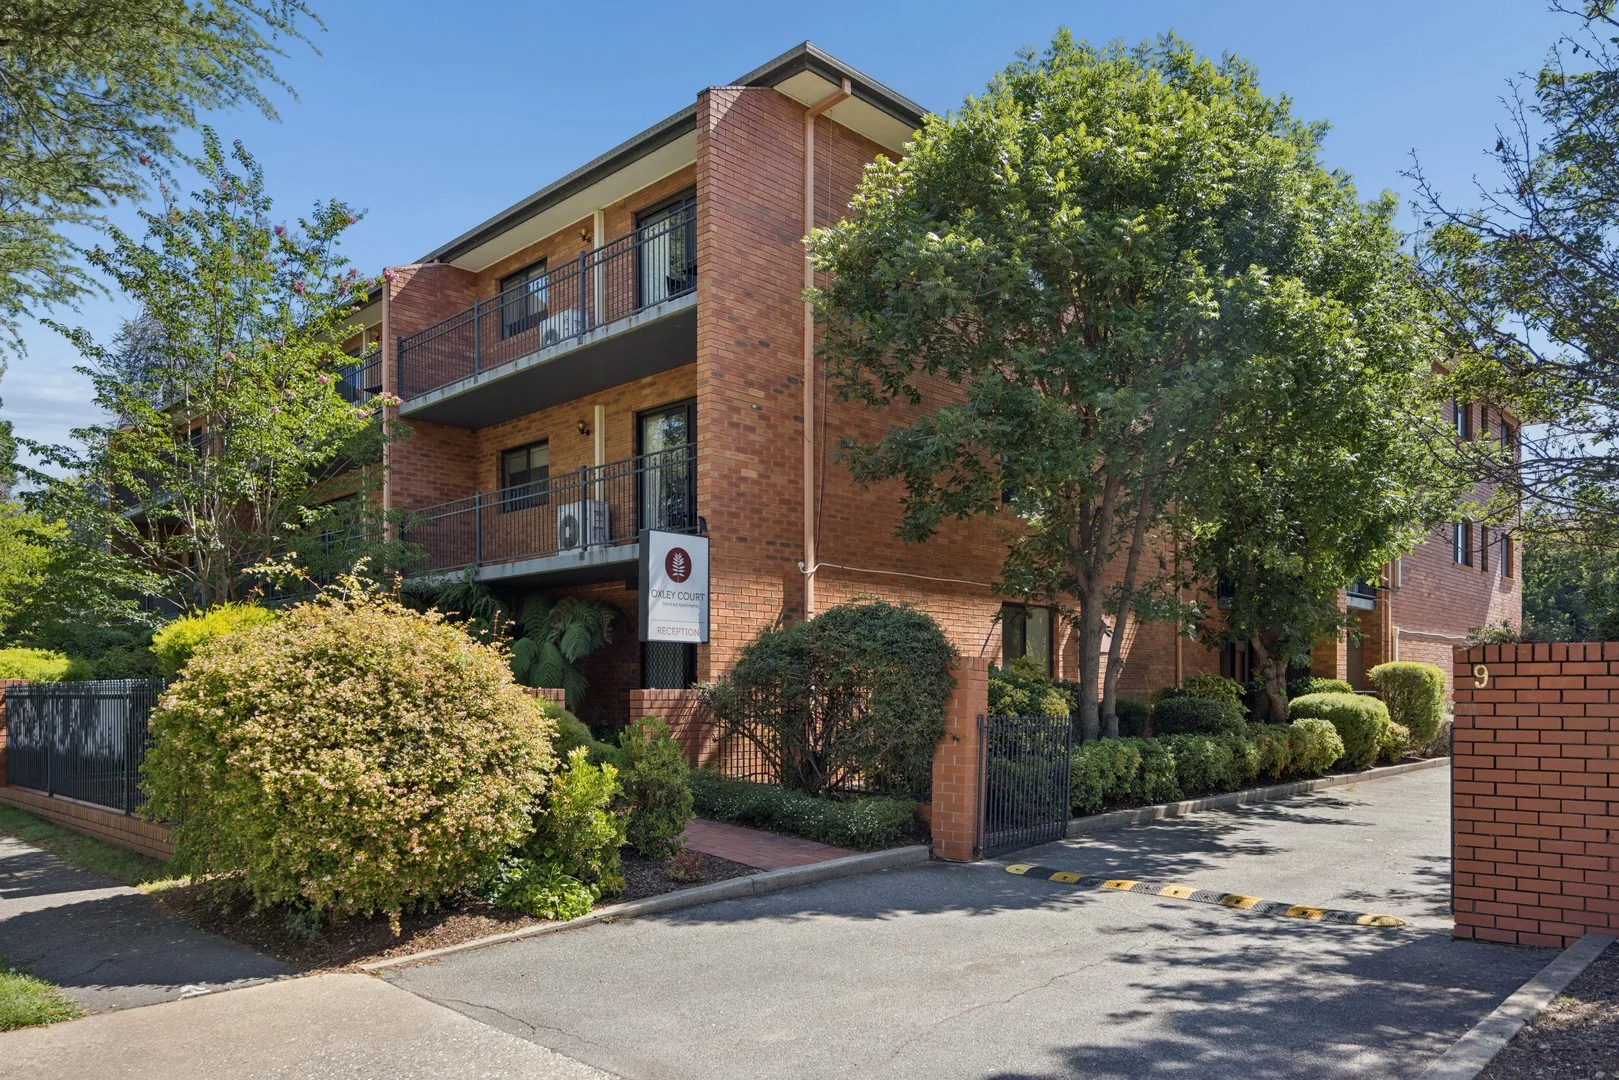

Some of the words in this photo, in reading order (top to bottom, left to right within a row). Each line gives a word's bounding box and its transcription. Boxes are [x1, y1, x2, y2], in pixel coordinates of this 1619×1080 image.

[651, 589, 675, 599] OXLEY
[677, 591, 705, 601] COURT
[657, 626, 700, 636] RECEPTION
[1474, 664, 1489, 689] 9
